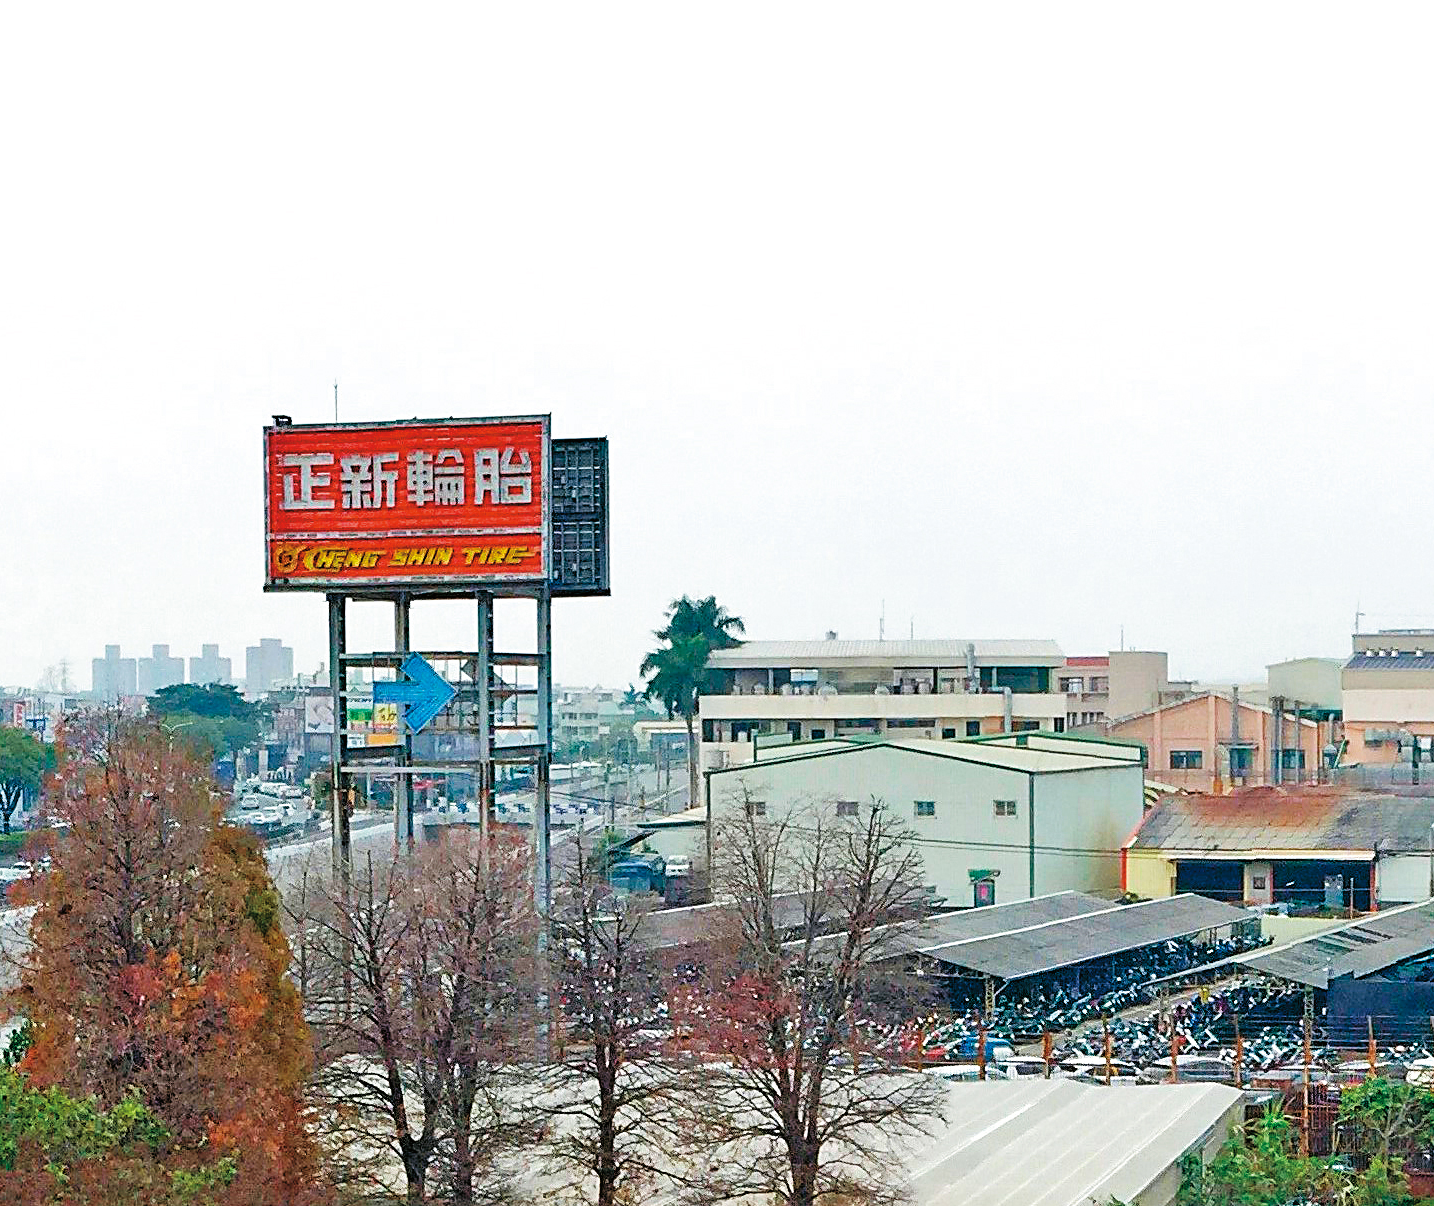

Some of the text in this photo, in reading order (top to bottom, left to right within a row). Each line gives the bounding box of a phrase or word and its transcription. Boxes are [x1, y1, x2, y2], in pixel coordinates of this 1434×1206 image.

[281, 447, 532, 511] 正新輪胎
[303, 545, 539, 571] CHENG SHIN TIRE
